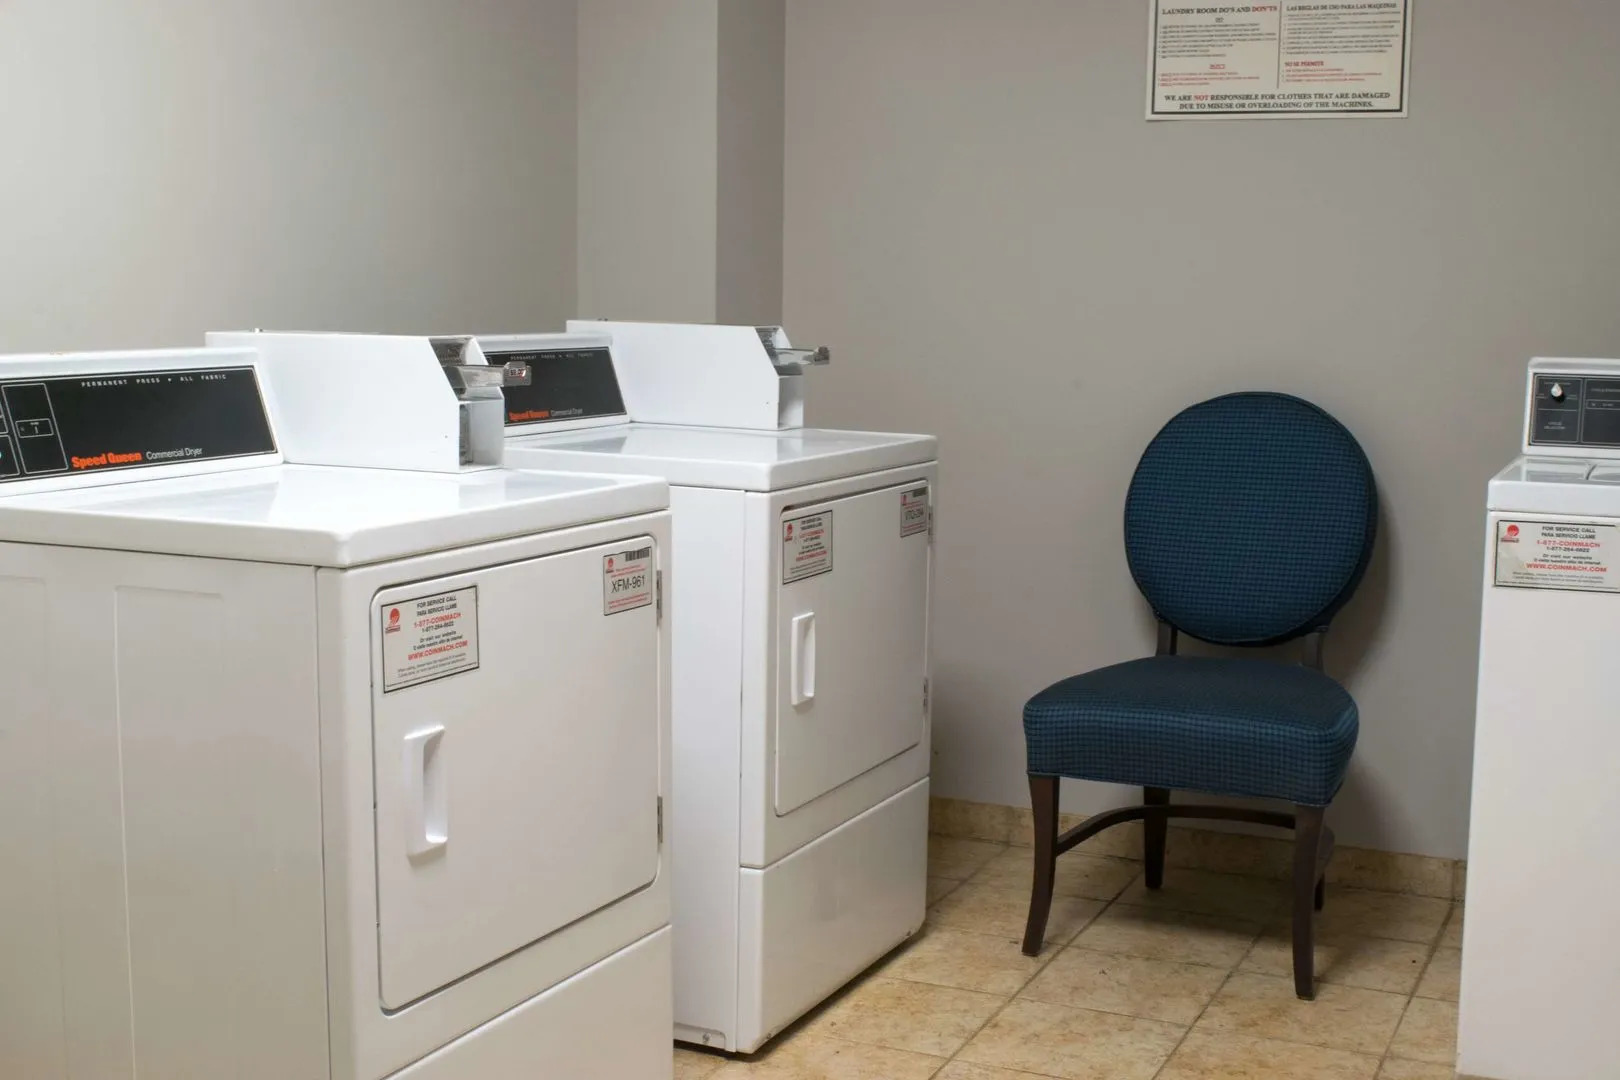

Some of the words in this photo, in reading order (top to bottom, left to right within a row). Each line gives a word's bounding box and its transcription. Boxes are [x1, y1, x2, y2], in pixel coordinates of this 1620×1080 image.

[81, 380, 127, 388] PERMANENT
[71, 454, 107, 469] Speed
[108, 452, 142, 464] Queen
[146, 449, 184, 460] Commercial
[185, 447, 202, 458] Dryer
[1526, 563, 1607, 572] WWW.COINMACH.COM
[611, 575, 646, 593] XFM-961
[427, 598, 445, 606] SERVICE
[414, 612, 462, 628] 1-877-COINMACH
[408, 640, 468, 660] WWW.COINMACH.COM
